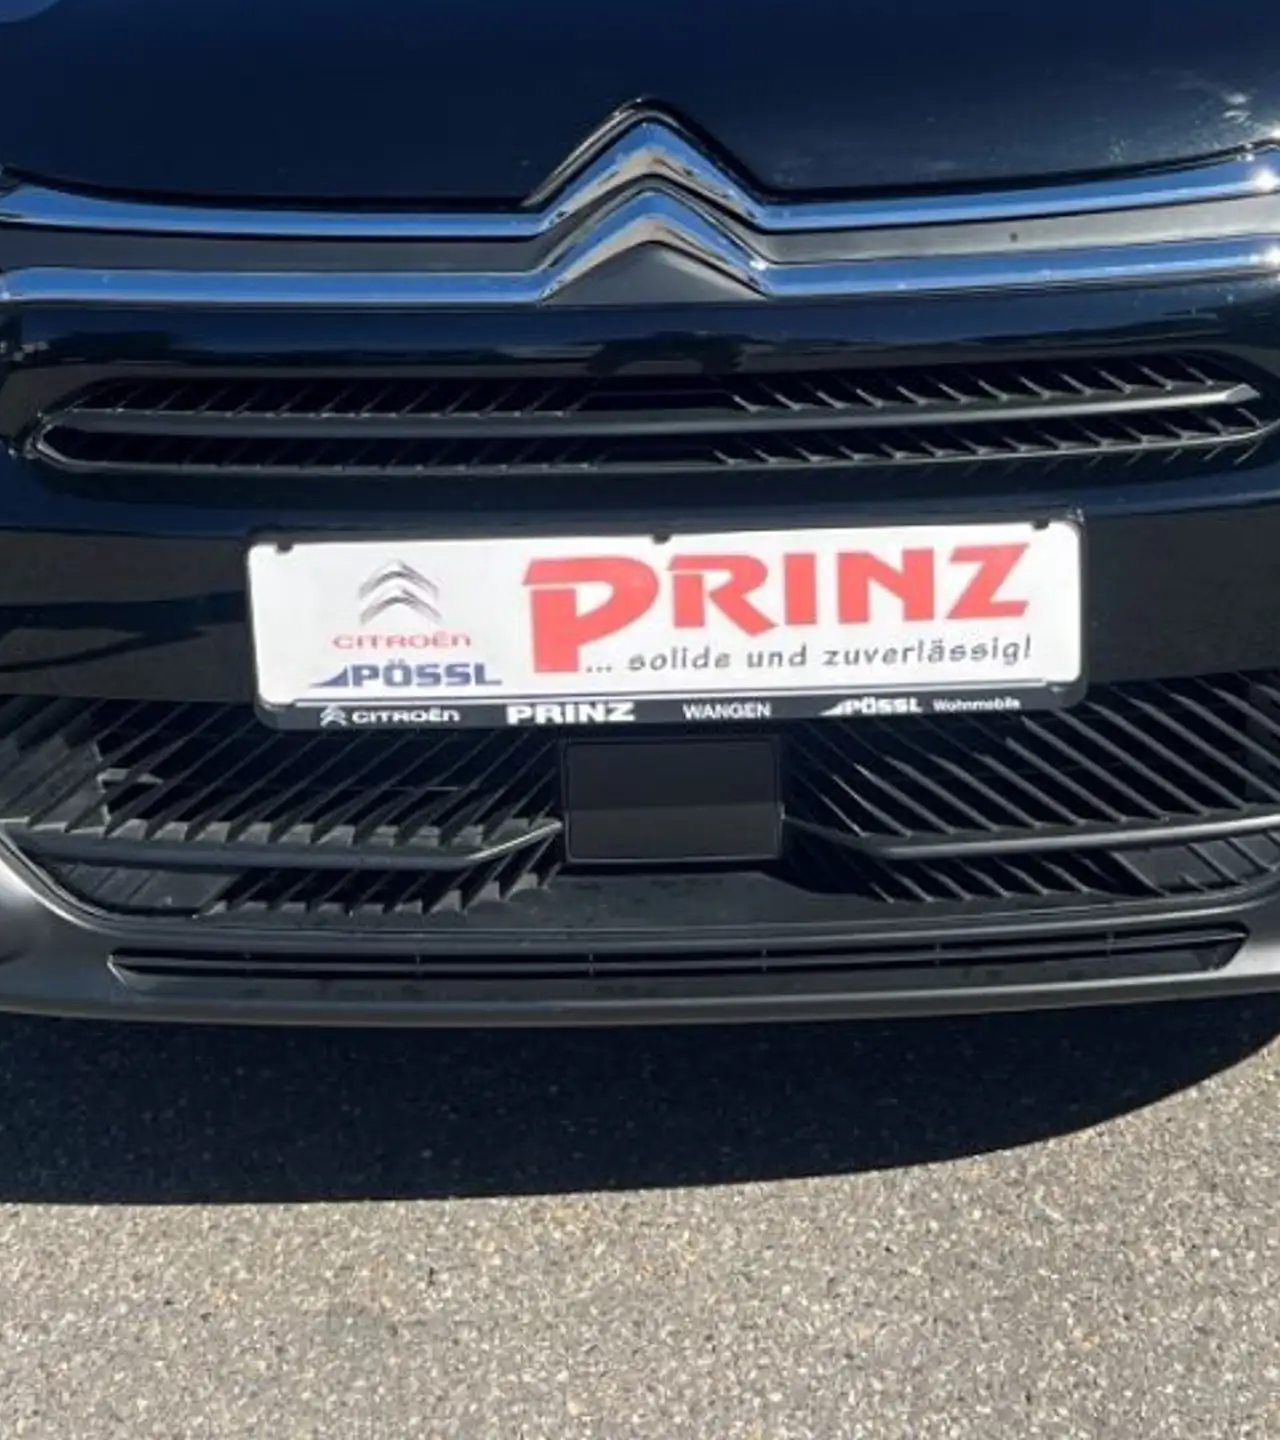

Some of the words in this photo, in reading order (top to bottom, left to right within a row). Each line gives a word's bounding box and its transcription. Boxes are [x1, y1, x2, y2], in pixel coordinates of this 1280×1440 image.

[522, 542, 1030, 674] PRINZ
[628, 646, 731, 671] solide
[747, 643, 807, 667] und
[822, 634, 1032, 666] zuverlässig!
[351, 659, 503, 687] PÖSSL
[506, 701, 636, 725] PRINZ
[682, 703, 772, 720] WANGEN
[844, 696, 923, 715] PÖSSL
